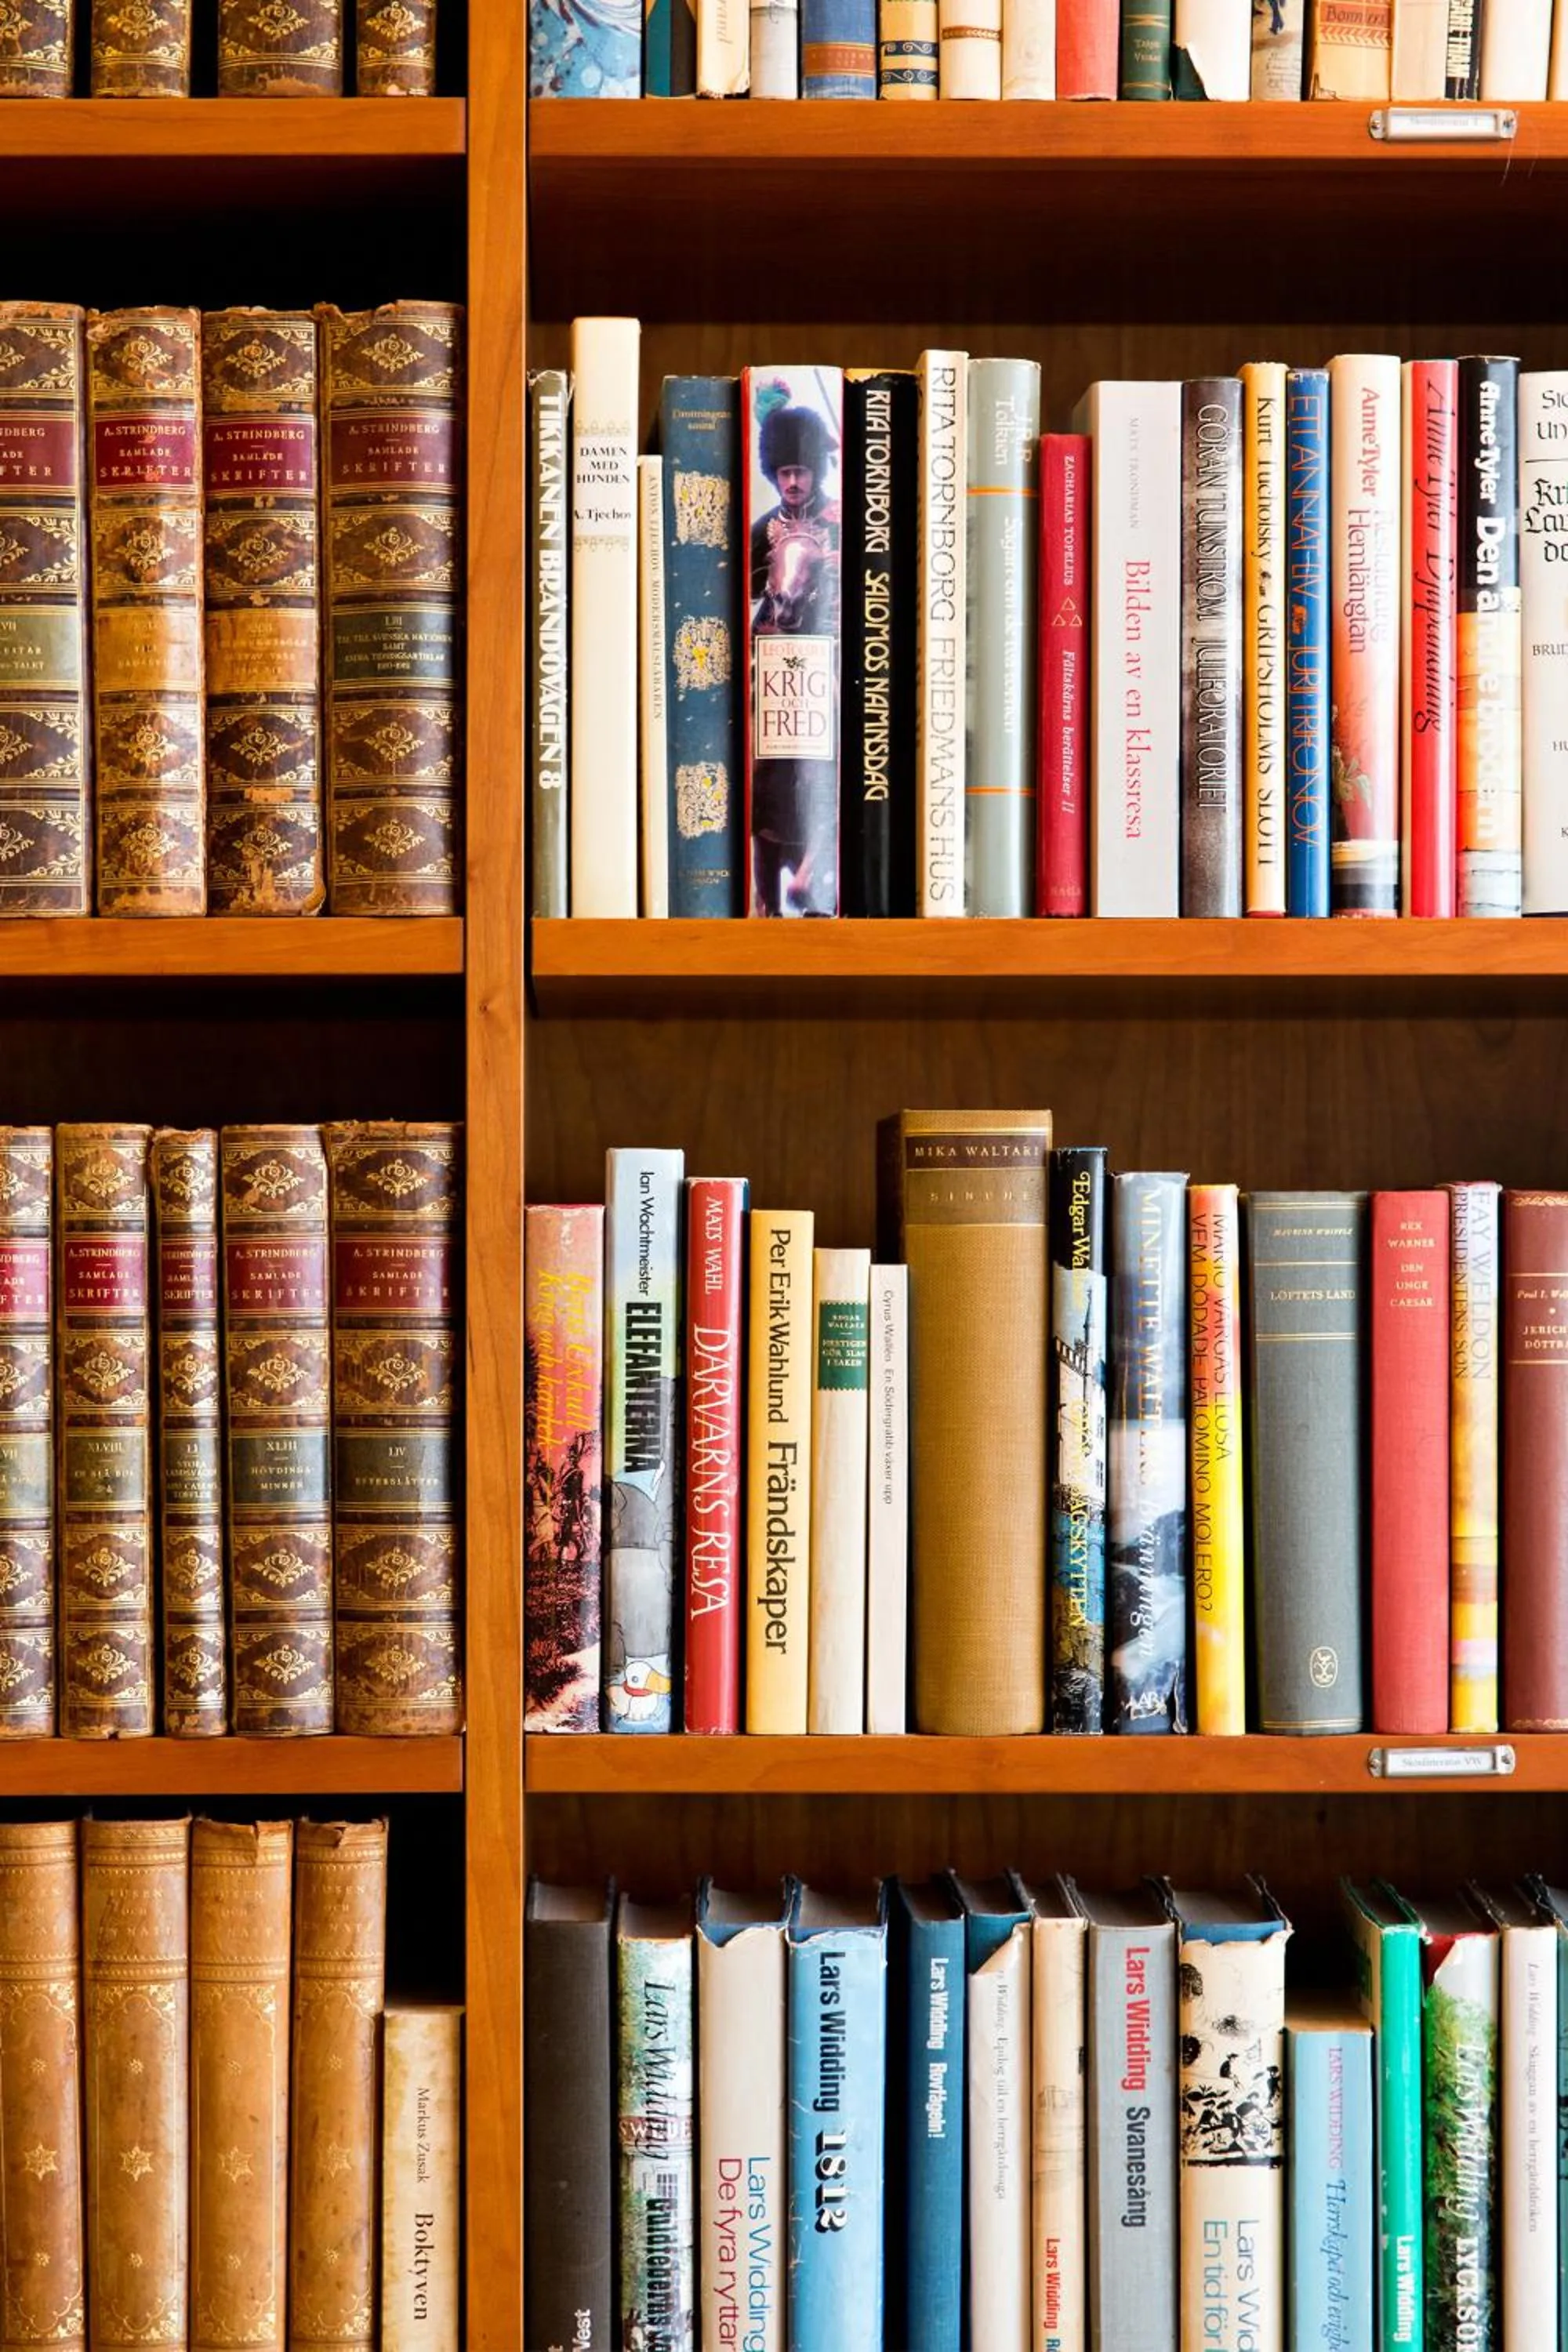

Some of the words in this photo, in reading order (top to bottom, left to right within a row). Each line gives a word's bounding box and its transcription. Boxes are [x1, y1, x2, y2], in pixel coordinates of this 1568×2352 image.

[1326, 5, 1388, 25] Bonniers
[1447, 36, 1472, 78] THAM
[361, 423, 441, 434] STRINDBERG
[865, 390, 891, 432] RITA
[931, 367, 956, 434] RITA
[1256, 396, 1279, 446] Kurt
[1291, 395, 1323, 440] ETT
[1361, 387, 1381, 444] Anne
[1427, 378, 1456, 466] Anne
[1479, 380, 1501, 445] Anne
[116, 426, 186, 436] STRINDBERG
[119, 447, 172, 457] SAMLADE
[226, 430, 305, 441] STRINDBERG
[233, 452, 283, 461] SAMLADE
[579, 446, 629, 458] DAMEN
[993, 396, 1018, 466] Tolkien
[1196, 404, 1232, 491] GÖRAN
[100, 466, 192, 477] SKRIFTER
[210, 469, 307, 482] SKRIFTER
[343, 463, 446, 474] SKRIFTER
[539, 391, 564, 541] TIKKANEN
[577, 473, 630, 485] HUNDEN
[590, 461, 619, 471] MED
[864, 434, 891, 554] TORNBORG
[1063, 455, 1076, 524] ZACHARIAS
[1357, 444, 1381, 497] Tyler
[1475, 445, 1501, 505] Tyler
[586, 508, 632, 524] Tjechov
[1250, 459, 1279, 562] Tucholsky
[1291, 444, 1323, 556] ANNAT
[1414, 468, 1457, 533] Tyler
[930, 436, 956, 623] TORNBORG
[1063, 527, 1075, 586] TOPELIUS
[1476, 515, 1507, 585] Den
[1125, 561, 1152, 642] Bilden
[1291, 561, 1323, 600] LIV
[1343, 510, 1371, 655] Hemlängtan
[863, 569, 891, 673] SALOMOS
[763, 670, 826, 698] KRIG
[1062, 649, 1076, 720] Fältskärns
[1125, 652, 1142, 679] av
[1256, 604, 1279, 775] GRIPSHOLMS
[763, 710, 827, 738] FRED
[781, 698, 809, 709] OCH
[1125, 689, 1142, 717] en
[1191, 638, 1229, 813] JULEORATORIET
[863, 677, 890, 801] NAMNSDAG
[929, 637, 956, 829] FRIEDMANS
[539, 770, 563, 790] 8
[1061, 726, 1075, 797] berättelser
[1125, 729, 1152, 839] klassresa
[1256, 788, 1279, 867] SLOTT
[929, 836, 956, 902] HUS
[915, 1147, 957, 1157] MIKA
[965, 1145, 1040, 1157] WALTARI
[638, 1171, 655, 1194] Ian
[1068, 1171, 1091, 1236] Edgar
[704, 1196, 724, 1242] MATS
[1191, 1213, 1208, 1264] VEM
[1400, 1221, 1423, 1231] REX
[1470, 1190, 1492, 1240] FAY
[246, 1247, 317, 1258] STRINDBERG
[638, 1197, 656, 1297] Wachtmeister
[768, 1229, 792, 1268] Per
[1139, 1186, 1163, 1333] MINETTE
[1213, 1214, 1231, 1289] MARIO
[1388, 1239, 1436, 1248] WARNER
[1400, 1263, 1424, 1273] DEN
[1453, 1192, 1469, 1333] PRESIDENTENS
[231, 1288, 321, 1300] SKRIFTER
[530, 1269, 564, 1327] Krig
[704, 1249, 724, 1295] WAHL
[768, 1272, 792, 1321] Erik
[1327, 1290, 1356, 1300] LAND
[1396, 1280, 1429, 1290] UNGE
[882, 1290, 895, 1321] Cyrus
[1192, 1273, 1210, 1366] DÖDADE
[1390, 1298, 1434, 1307] CAESAR
[1470, 1251, 1493, 1380] WELDON
[539, 1330, 564, 1368] och
[1213, 1295, 1232, 1384] VARGAS
[1454, 1340, 1469, 1380] SON
[624, 1301, 662, 1474] ELEFANTERNA
[768, 1322, 791, 1424] Wahlund
[884, 1369, 895, 1383] En
[690, 1323, 734, 1517] DARVARNS
[1193, 1377, 1211, 1493] PALOMINO
[1214, 1392, 1233, 1461] LLOSA
[882, 1484, 894, 1504] upp
[690, 1526, 731, 1621] RESA
[757, 1441, 799, 1655] Frändskaper
[1195, 1503, 1213, 1612] MOLERO?
[819, 1951, 846, 2005] Lars
[930, 1958, 949, 1990] Lars
[1125, 1946, 1151, 1995] Lars
[644, 1980, 677, 2041] Lars
[926, 1991, 949, 2049] Widding
[812, 2010, 846, 2112] Widding
[1120, 1998, 1151, 2092] Widding
[1327, 2047, 1343, 2083] LARS
[1454, 2043, 1488, 2101] Lars
[416, 2086, 430, 2138] Markus
[635, 2046, 678, 2161] Widding
[1327, 2084, 1343, 2169] WIDDING
[1528, 2120, 1537, 2134] en
[416, 2143, 428, 2184] Zusak
[717, 2158, 742, 2201] De
[747, 2157, 771, 2220] Lars
[814, 2129, 851, 2233] 1812
[1120, 2107, 1152, 2228] Svanesång
[1445, 2106, 1489, 2221] Widding
[713, 2208, 742, 2263] fyra
[1045, 2238, 1061, 2268] Lars
[1203, 2220, 1229, 2258] En
[1236, 2220, 1260, 2281] Lars
[1319, 2179, 1347, 2277] Herrskapet
[1396, 2234, 1415, 2271] Lars
[408, 2212, 435, 2321] Boktyven
[742, 2224, 771, 2352] Widding
[1203, 2263, 1229, 2299] tid
[1326, 2278, 1349, 2305] och
[1041, 2273, 1061, 2329] Widding
[1203, 2307, 1229, 2341] för
[1392, 2274, 1415, 2343] Widding
